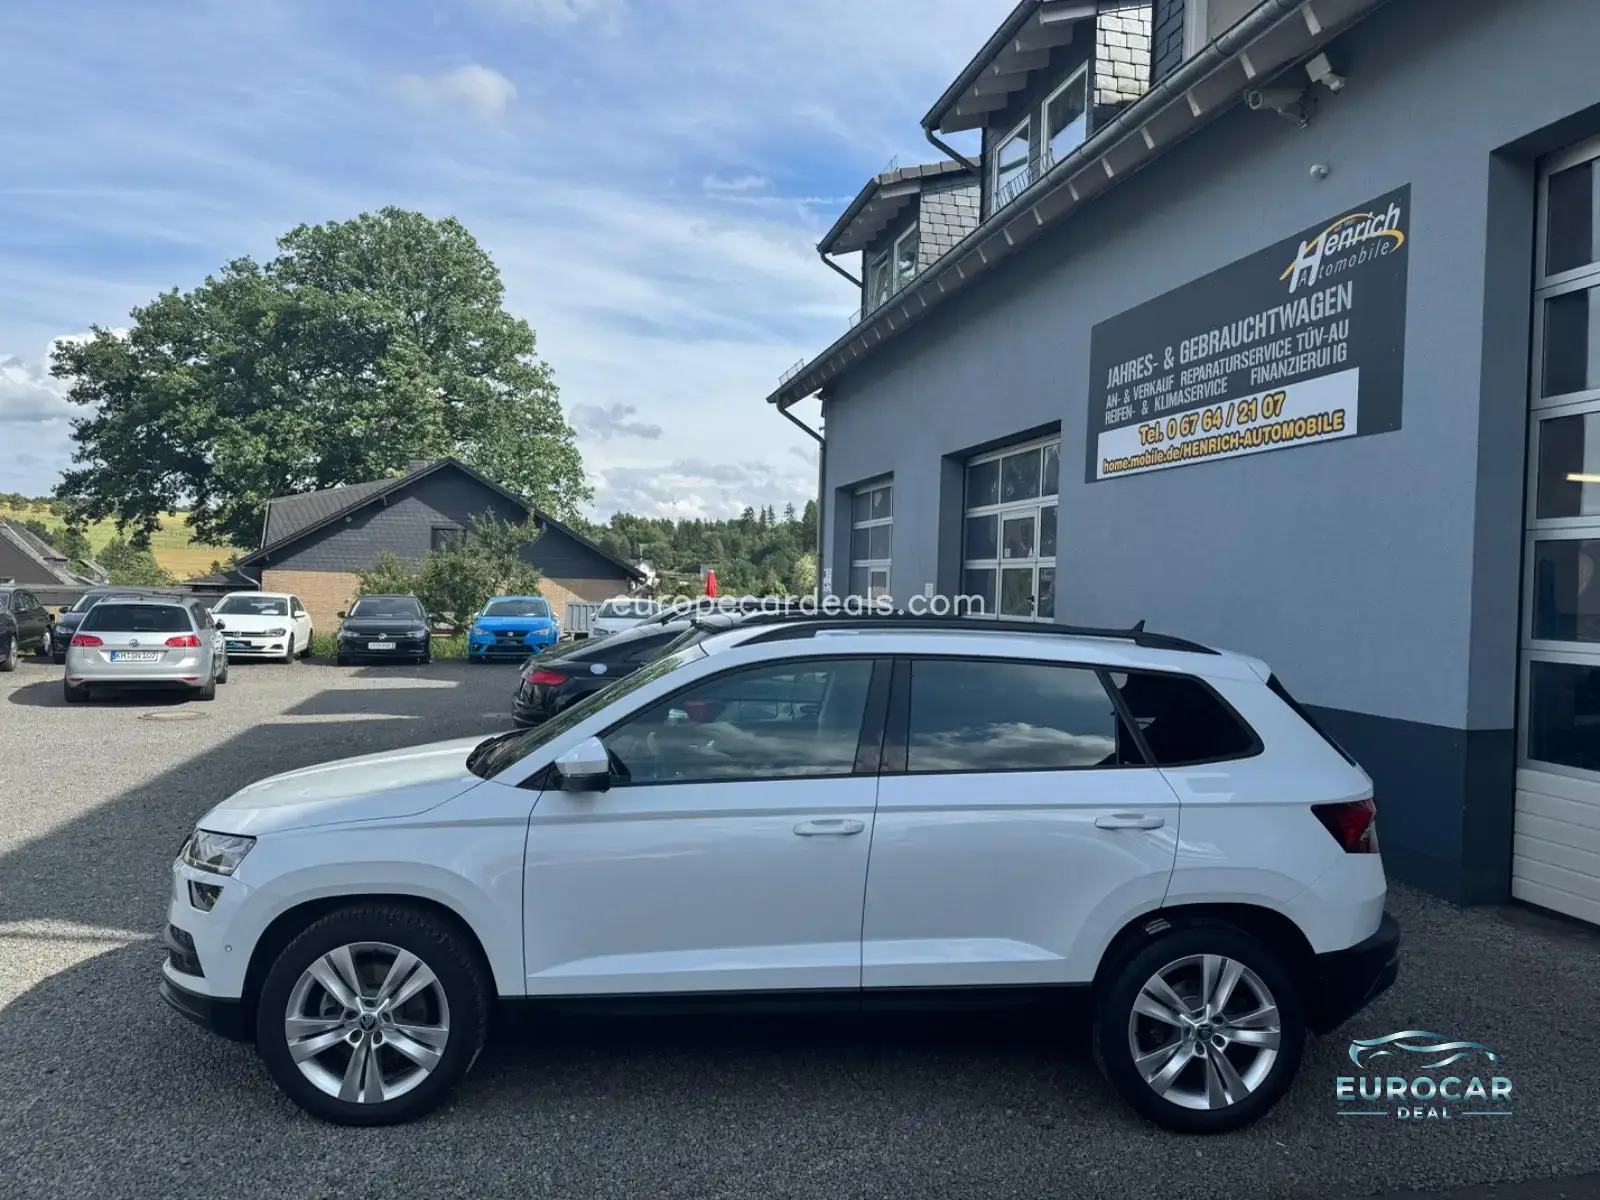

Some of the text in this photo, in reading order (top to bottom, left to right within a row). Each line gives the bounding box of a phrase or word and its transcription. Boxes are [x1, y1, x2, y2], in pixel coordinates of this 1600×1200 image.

[1288, 202, 1401, 293] Henrich
[1298, 239, 1390, 287] Atomobile
[1105, 318, 1350, 410] AN- & VERKAUF REPARATURSERVICE TÜV-AU
[1106, 280, 1353, 390] JAHRES- & GEBRAUCHTWAGEN
[1105, 404, 1137, 425] REIFEN-
[1141, 399, 1149, 415] &
[1154, 376, 1229, 412] KLIMASERVICE
[1140, 391, 1287, 445] Tel. 0 67 64 / 21 07
